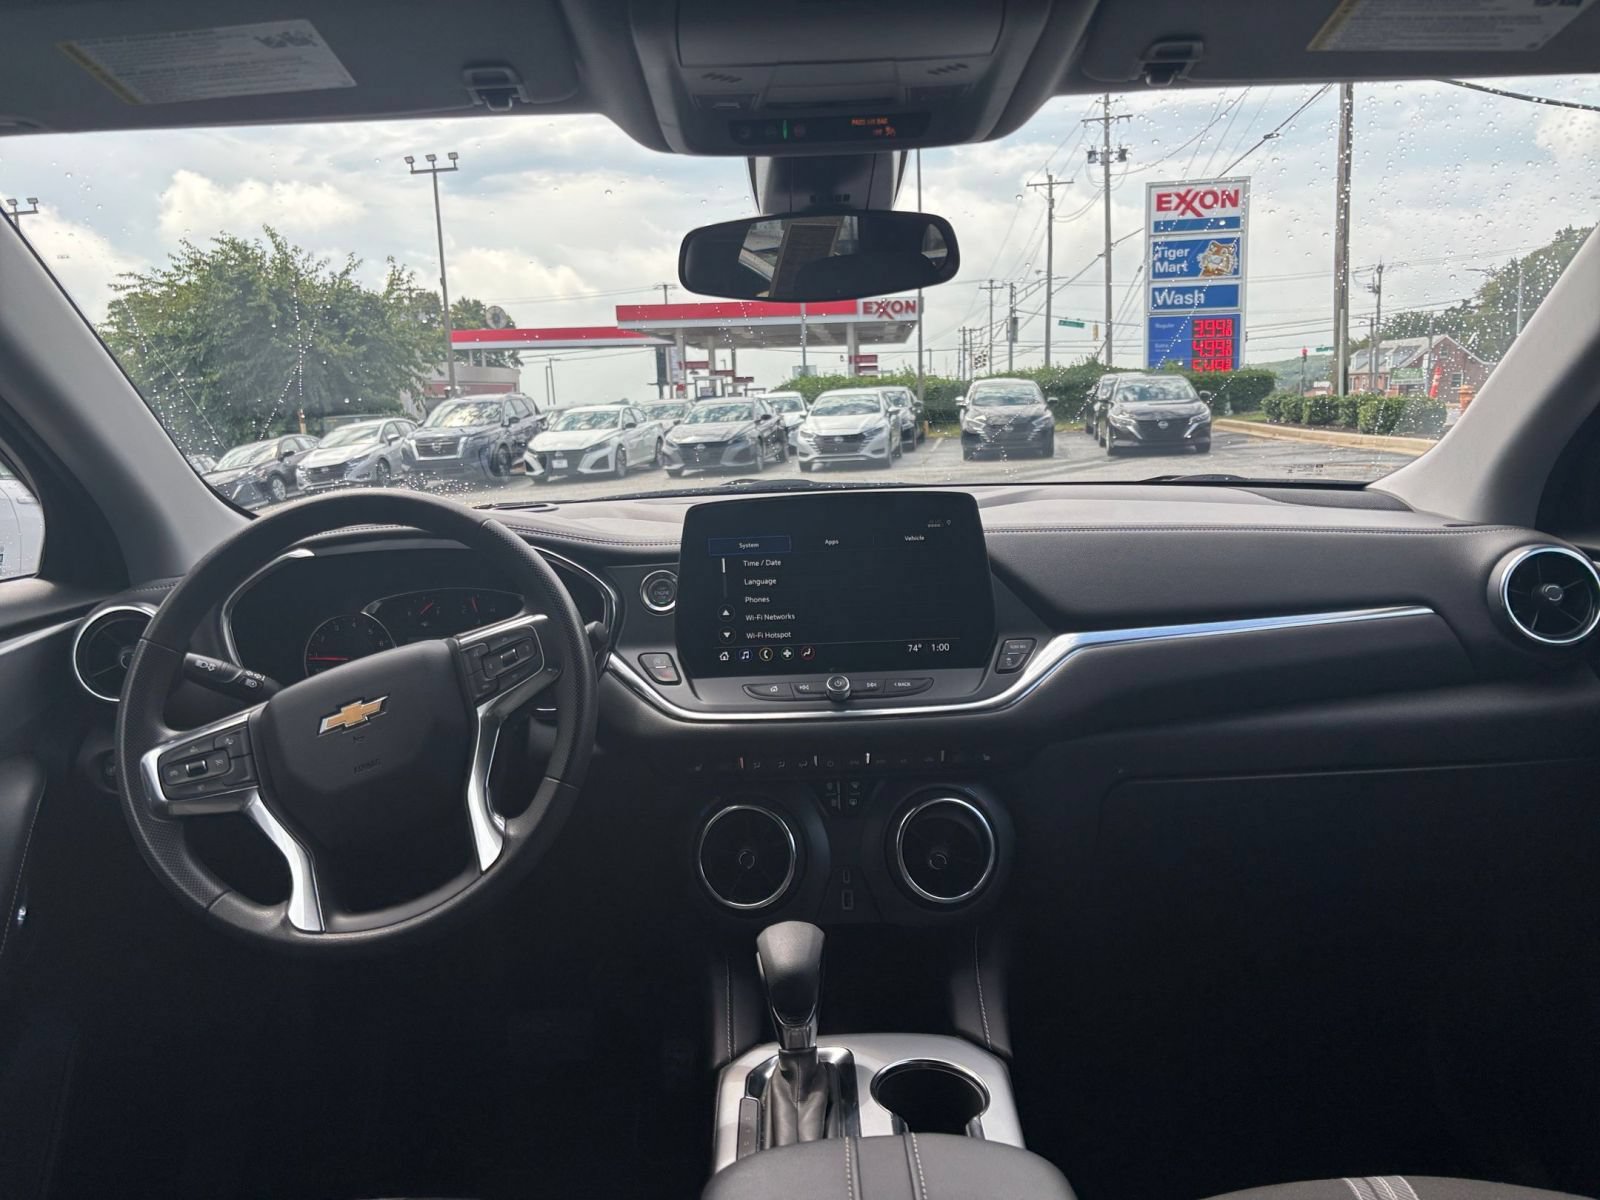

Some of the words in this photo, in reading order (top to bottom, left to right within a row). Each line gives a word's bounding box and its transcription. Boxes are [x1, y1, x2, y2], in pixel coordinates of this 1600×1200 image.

[1155, 188, 1240, 218] EXXON
[1154, 246, 1190, 260] Tiger
[1155, 260, 1189, 273] Mart
[1154, 289, 1205, 305] Wash
[862, 299, 916, 319] EXXON
[825, 538, 839, 546] Apps
[904, 534, 925, 542] Vehicle
[738, 541, 760, 550] System
[743, 559, 760, 567] Time
[765, 558, 782, 567] Date
[744, 577, 777, 587] Language
[745, 613, 764, 621] Wi-Fi
[765, 612, 796, 621] Networks
[746, 631, 764, 639] Wi-Fi
[765, 630, 792, 640] Hotspot
[931, 642, 950, 652] 1:00
